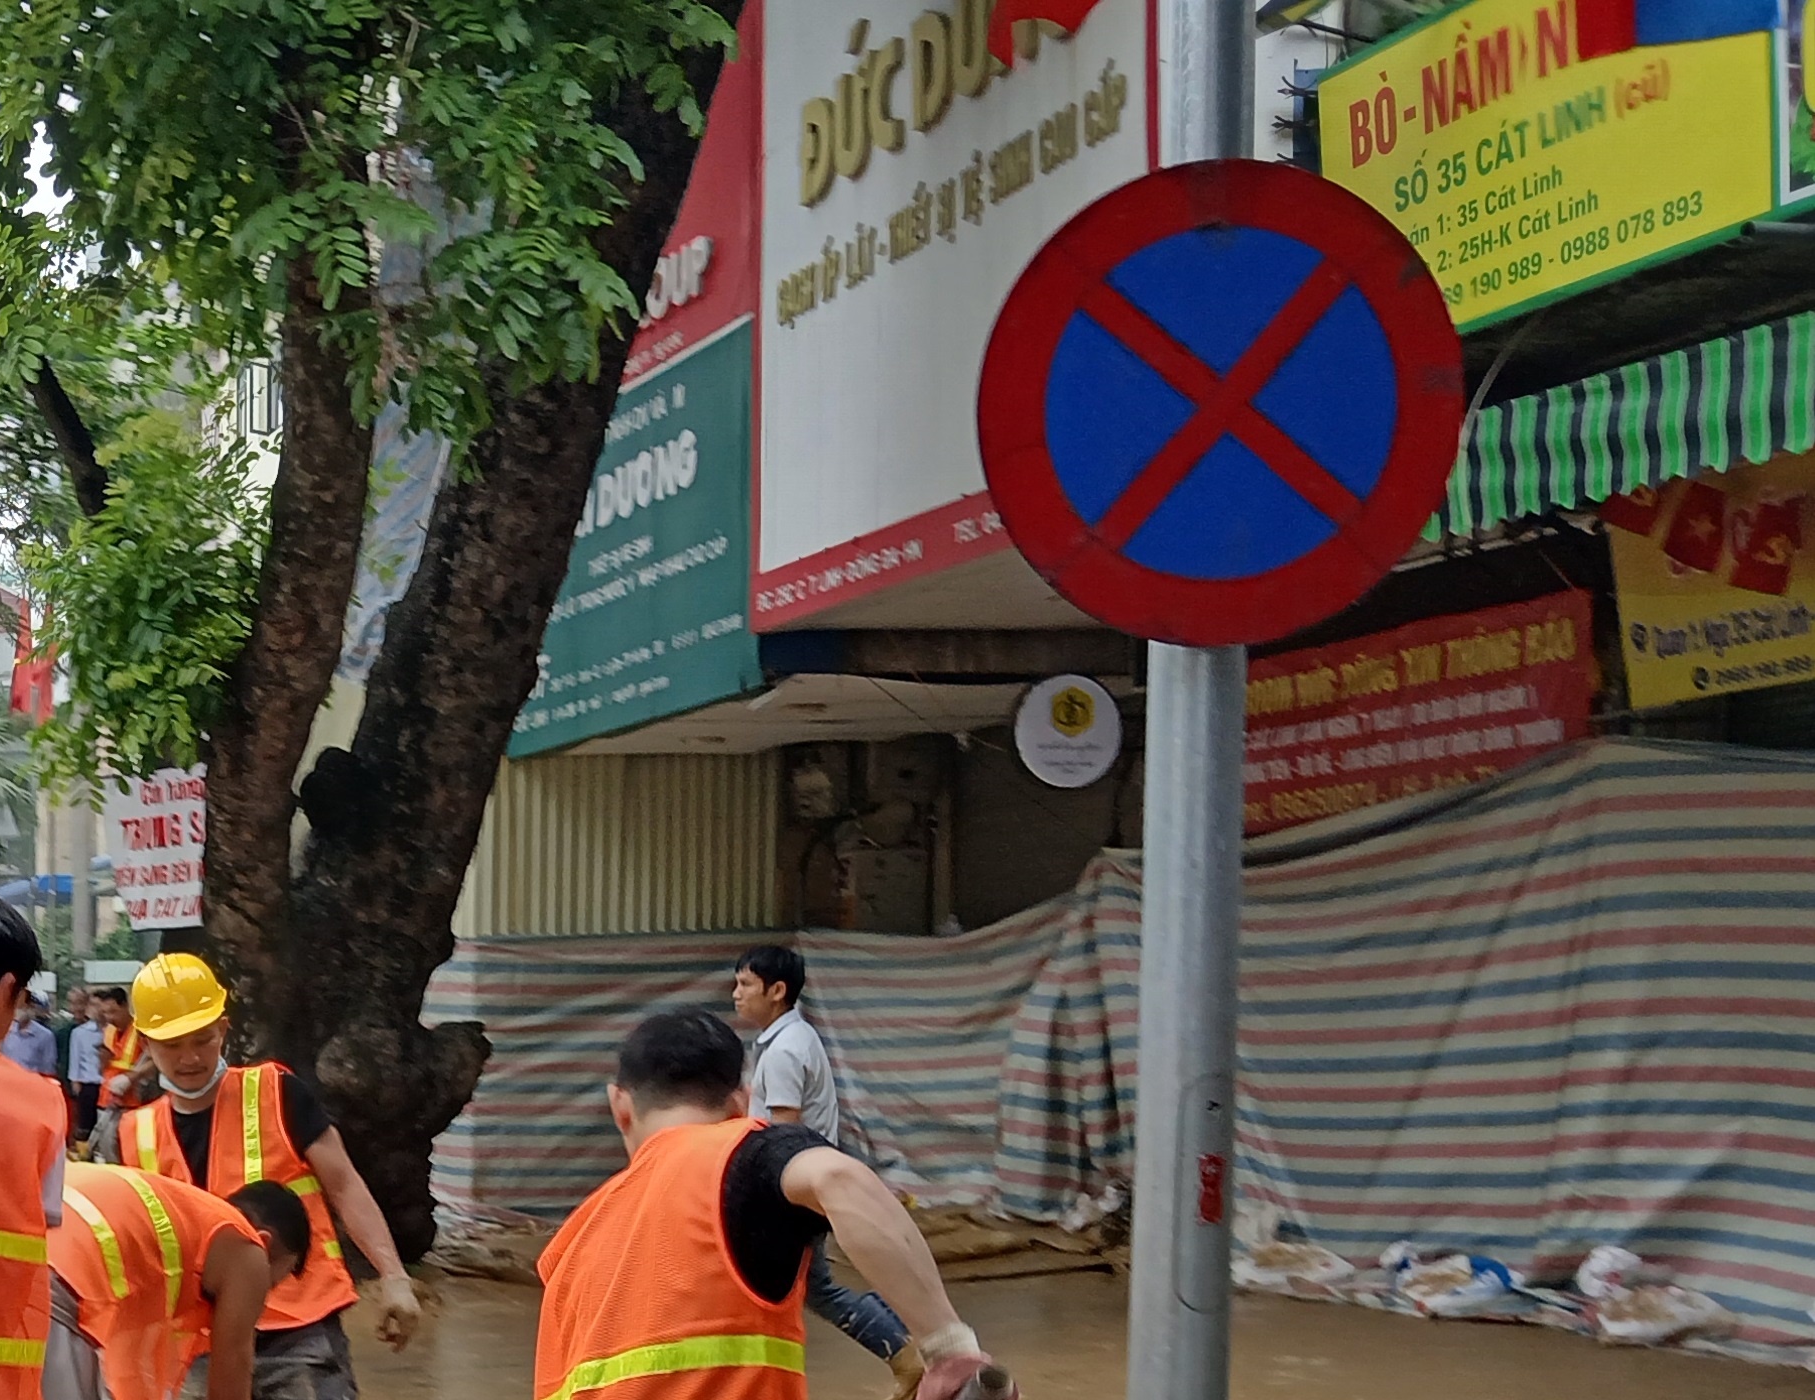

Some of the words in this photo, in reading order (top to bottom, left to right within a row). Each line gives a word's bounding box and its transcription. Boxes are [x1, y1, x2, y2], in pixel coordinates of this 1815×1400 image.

[800, 18, 906, 209] ĐỨC
[1394, 148, 1429, 213] SỐ
[1436, 151, 1467, 195] 35
[1475, 118, 1531, 177] CÁT
[1538, 86, 1606, 149] LINH
[1456, 199, 1479, 229] 35
[1485, 184, 1517, 217] Cát
[1522, 164, 1564, 202] Linh
[1459, 222, 1513, 266] 25H-K
[1518, 204, 1552, 241] Cát
[1557, 188, 1600, 228] Linh
[1470, 268, 1502, 299] 190
[1507, 252, 1543, 286] 989
[1560, 227, 1610, 265] 0988
[1616, 208, 1656, 244] 078
[1663, 191, 1704, 227] 893
